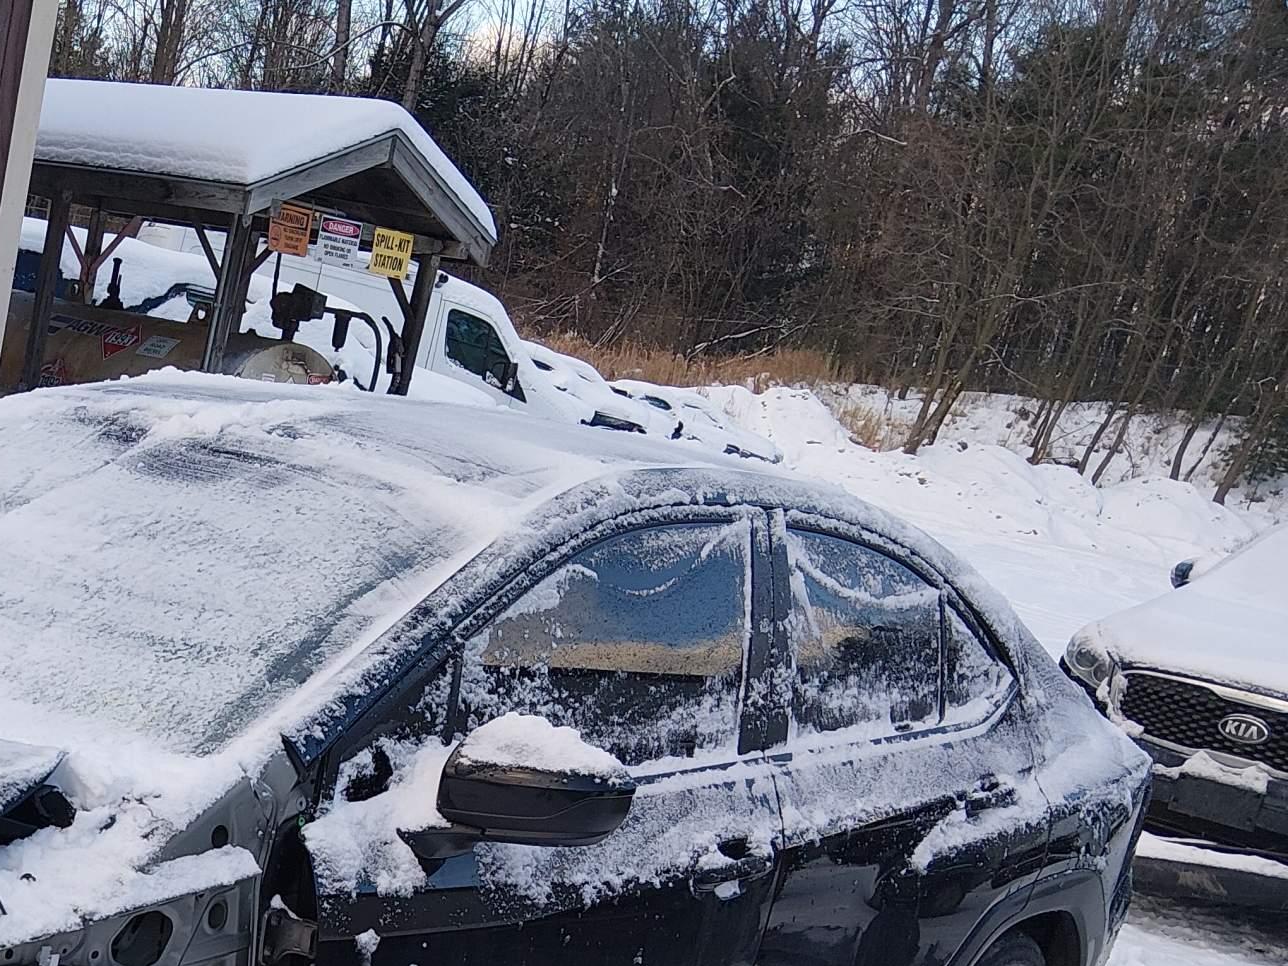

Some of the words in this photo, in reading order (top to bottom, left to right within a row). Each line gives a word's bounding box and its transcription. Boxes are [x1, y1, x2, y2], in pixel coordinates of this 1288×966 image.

[279, 210, 305, 227] ARNING
[328, 223, 354, 235] DANGER
[376, 233, 411, 253] SPILL-KIT
[373, 253, 404, 272] STATION
[1225, 720, 1258, 739] KIA
